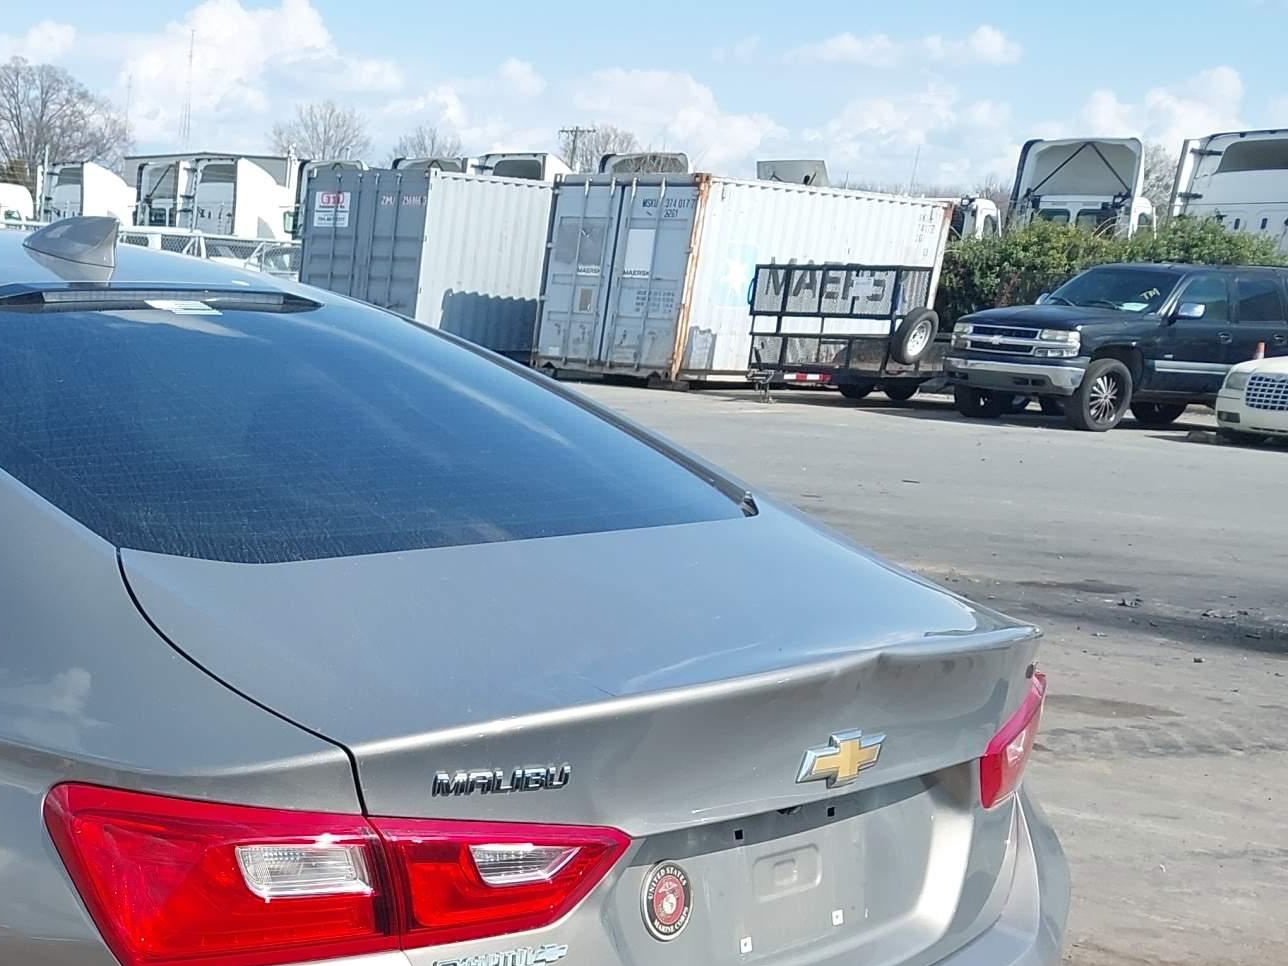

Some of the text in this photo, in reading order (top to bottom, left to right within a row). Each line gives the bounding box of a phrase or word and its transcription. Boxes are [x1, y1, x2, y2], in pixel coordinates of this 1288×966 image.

[642, 198, 659, 208] MSKU
[431, 762, 572, 798] MALIBU
[647, 866, 688, 900] UNITED STATES
[653, 905, 690, 933] MARINE CORPS
